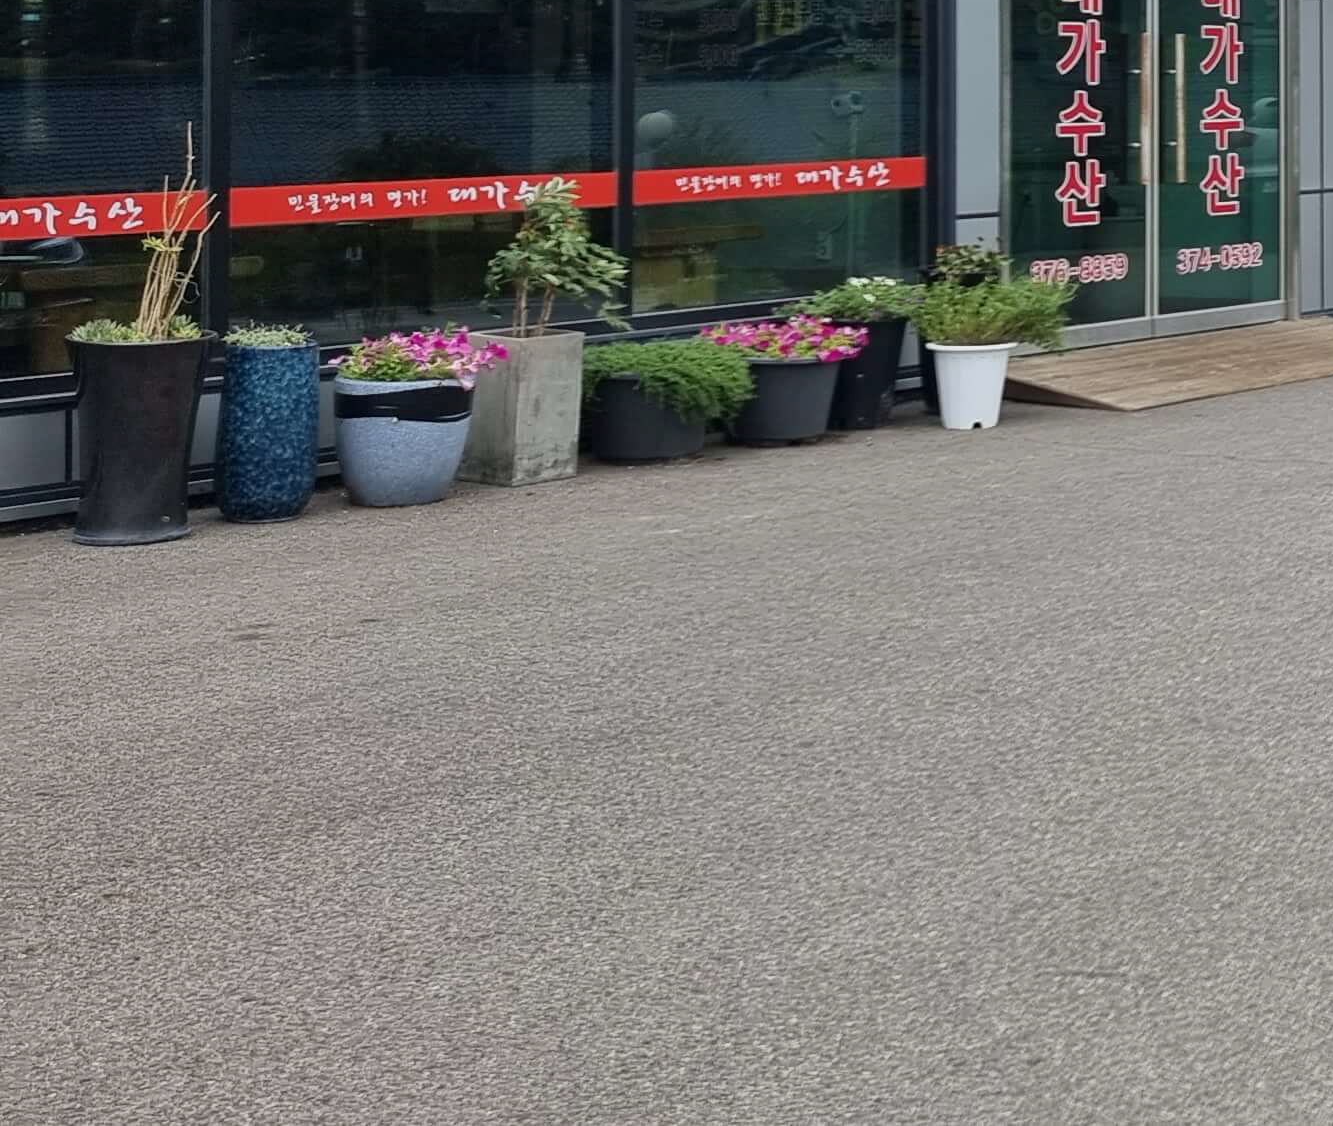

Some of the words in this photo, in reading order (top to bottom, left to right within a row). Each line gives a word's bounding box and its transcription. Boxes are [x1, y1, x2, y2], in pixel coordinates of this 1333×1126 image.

[674, 174, 743, 194] 민물장어의
[795, 161, 891, 191] 대가수산
[287, 192, 374, 214] 민물장어의
[387, 188, 429, 208] 명가!
[447, 180, 545, 210] 대가수
[1176, 241, 1264, 275] 374-0592
